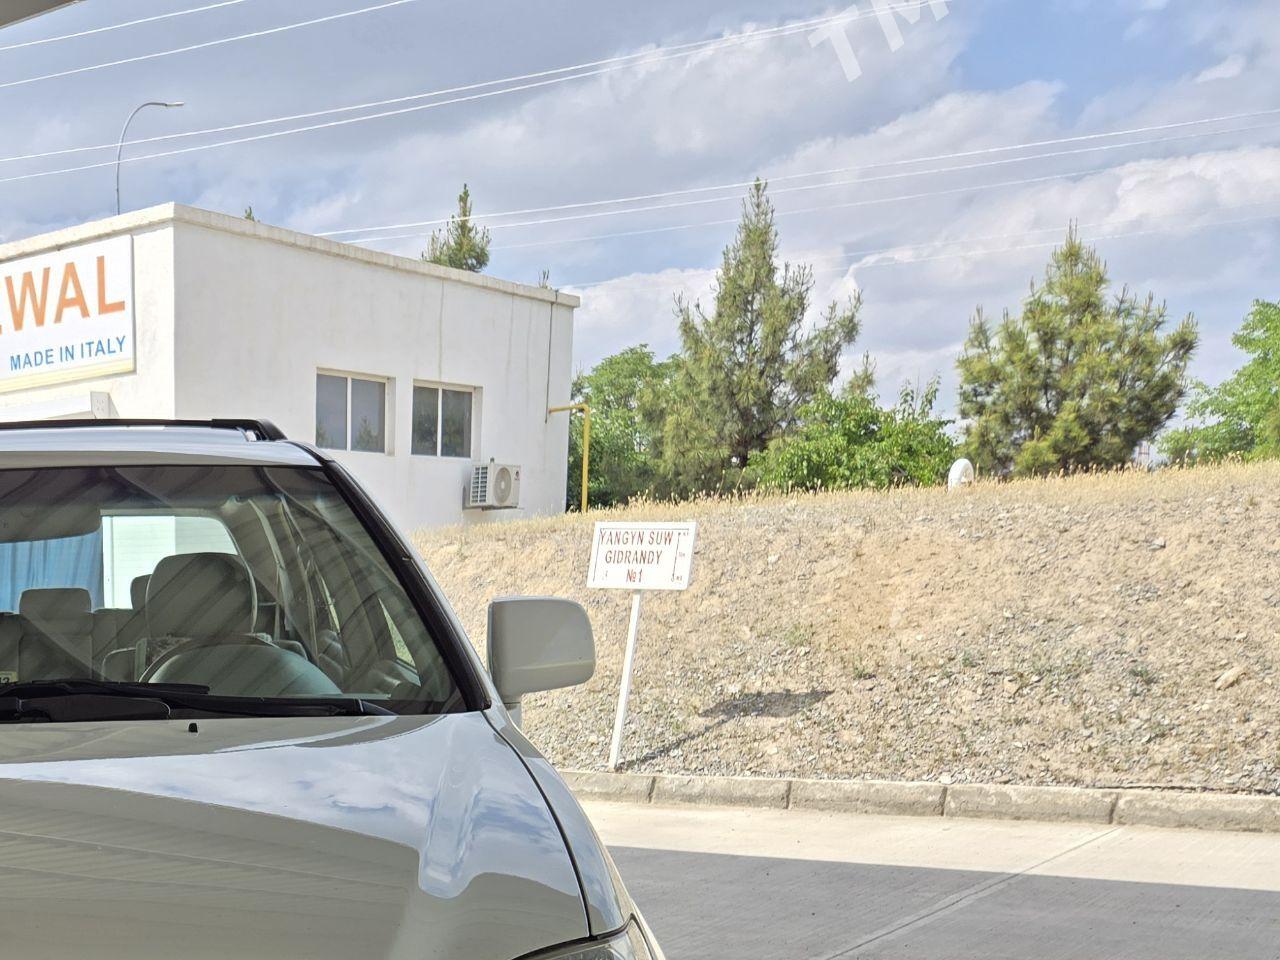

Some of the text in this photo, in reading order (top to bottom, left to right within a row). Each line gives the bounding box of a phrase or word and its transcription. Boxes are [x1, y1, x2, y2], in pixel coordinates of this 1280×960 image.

[10, 335, 126, 371] MADE IN ITALY
[600, 530, 645, 545] YANGYN
[648, 530, 674, 545] SUW
[605, 550, 663, 565] GIDRANDY
